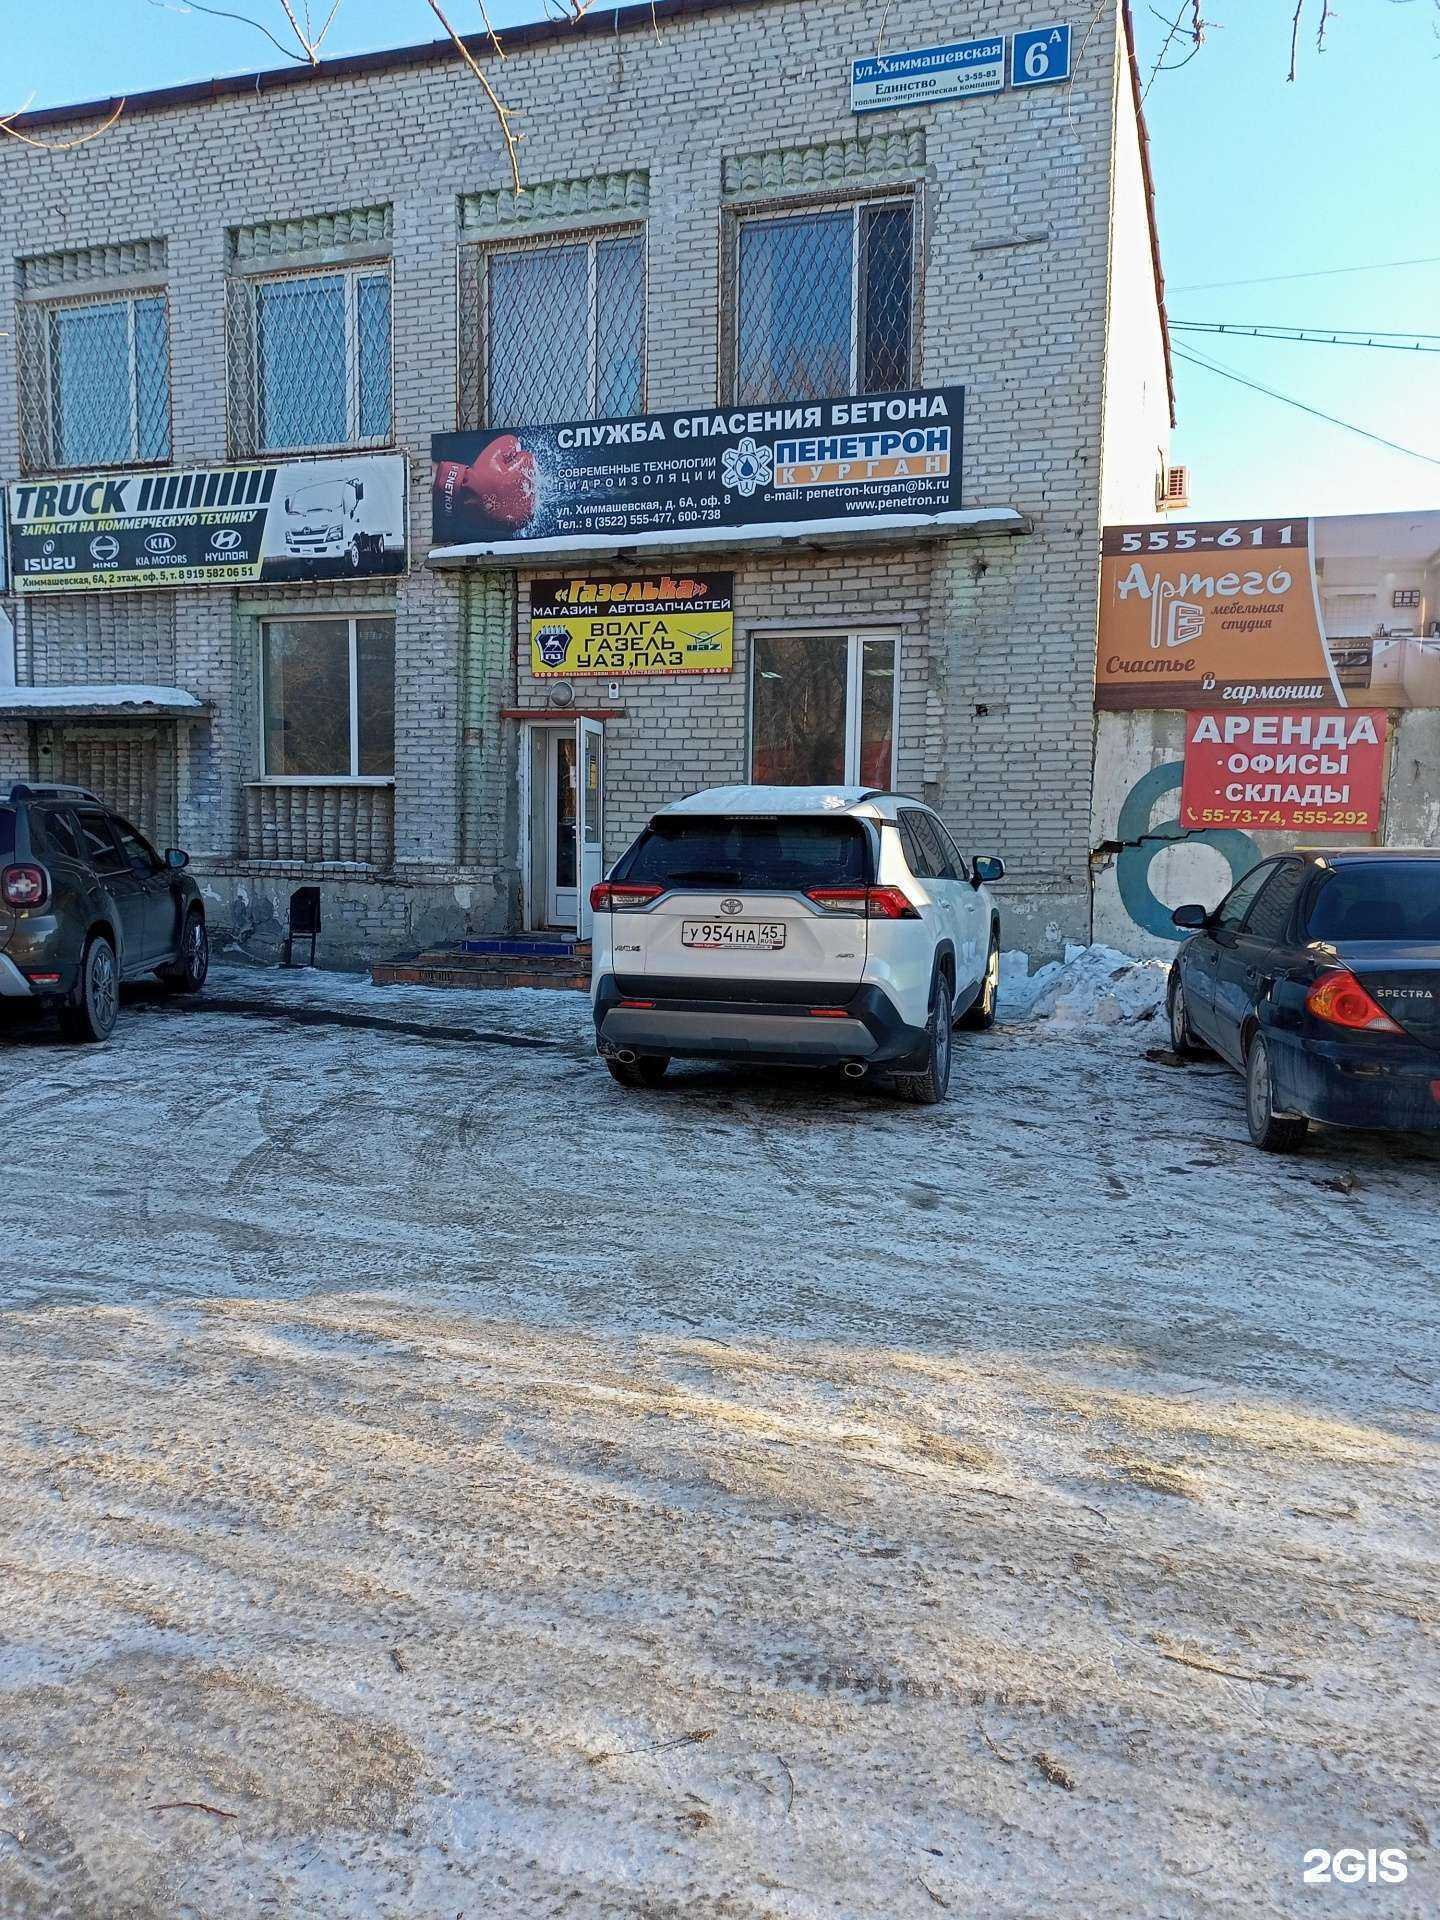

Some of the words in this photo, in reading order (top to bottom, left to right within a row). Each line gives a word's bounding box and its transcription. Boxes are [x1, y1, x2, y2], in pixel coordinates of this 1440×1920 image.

[875, 79, 937, 96] Единство
[959, 79, 1000, 91] компании
[557, 421, 665, 448] СЛУЖБА
[673, 406, 821, 438] СПАСЕНИЯ
[831, 395, 949, 426] БЕТОНА
[776, 428, 949, 464] ПЕНЕТРОН
[558, 463, 641, 479] СОВРЕМЕННЫЕ
[643, 457, 716, 473] ТЕХНОЛОГИИ
[782, 457, 941, 484] КУРГАН
[558, 470, 716, 491] ГИДРОИЗОЛЯЦИИ
[16, 479, 132, 519] TRUCK
[764, 490, 802, 502] e-mail:
[806, 480, 950, 501] penetron-kurgan@bk.ru
[557, 507, 573, 518] ул.
[575, 501, 663, 515] Химмашевская,
[665, 500, 676, 511] д.
[679, 496, 697, 509] 6А,
[700, 496, 721, 508] оф.
[724, 494, 731, 505] 8
[846, 494, 950, 511] www.penetron.ru
[21, 522, 78, 537] ЗАПЧАСТИ
[79, 520, 95, 534] НА
[97, 514, 198, 532] КОММЕРЧЕСКУЮ
[200, 510, 258, 525] ТЕХНИКУ
[557, 519, 583, 530] Тел.:
[585, 518, 592, 528] 8
[595, 515, 627, 530] (3522)
[630, 512, 675, 526] 555-477,
[678, 509, 721, 522] 600-738
[150, 537, 171, 549] KIA
[24, 556, 76, 571] ISUZU
[135, 557, 150, 566] KIA
[152, 554, 188, 565] MOTORS
[205, 551, 249, 561] HYUNDAI
[22, 576, 91, 587] Химмашевская,
[109, 574, 115, 583] 2
[116, 574, 141, 583] этаж,
[143, 571, 158, 582] оф.
[160, 571, 168, 580] 5,
[178, 570, 185, 579] 8
[186, 569, 205, 579] 919
[206, 568, 225, 578] 582
[227, 567, 239, 577] 06
[241, 566, 254, 576] 51
[533, 605, 598, 617] МАГАЗИН
[608, 598, 732, 615] АВТОЗАПЧАСТЕЙ
[1117, 562, 1293, 648] Артего
[1211, 601, 1285, 616] мебельная
[590, 621, 668, 637] ВОЛГА
[1221, 618, 1273, 632] студия
[584, 635, 675, 652] ГАЗЕЛЬ
[1106, 655, 1196, 674] Счастье
[1222, 684, 1325, 705] гармонии
[1192, 716, 1378, 750] АРЕНДА
[1227, 753, 1349, 775] ОФИСЫ
[1225, 784, 1349, 806] СКЛАДЫ
[1202, 808, 1286, 825] 55-73-74,
[1292, 809, 1368, 825] 555-292
[761, 925, 778, 939] 45
[1377, 989, 1433, 998] SPECTRA
